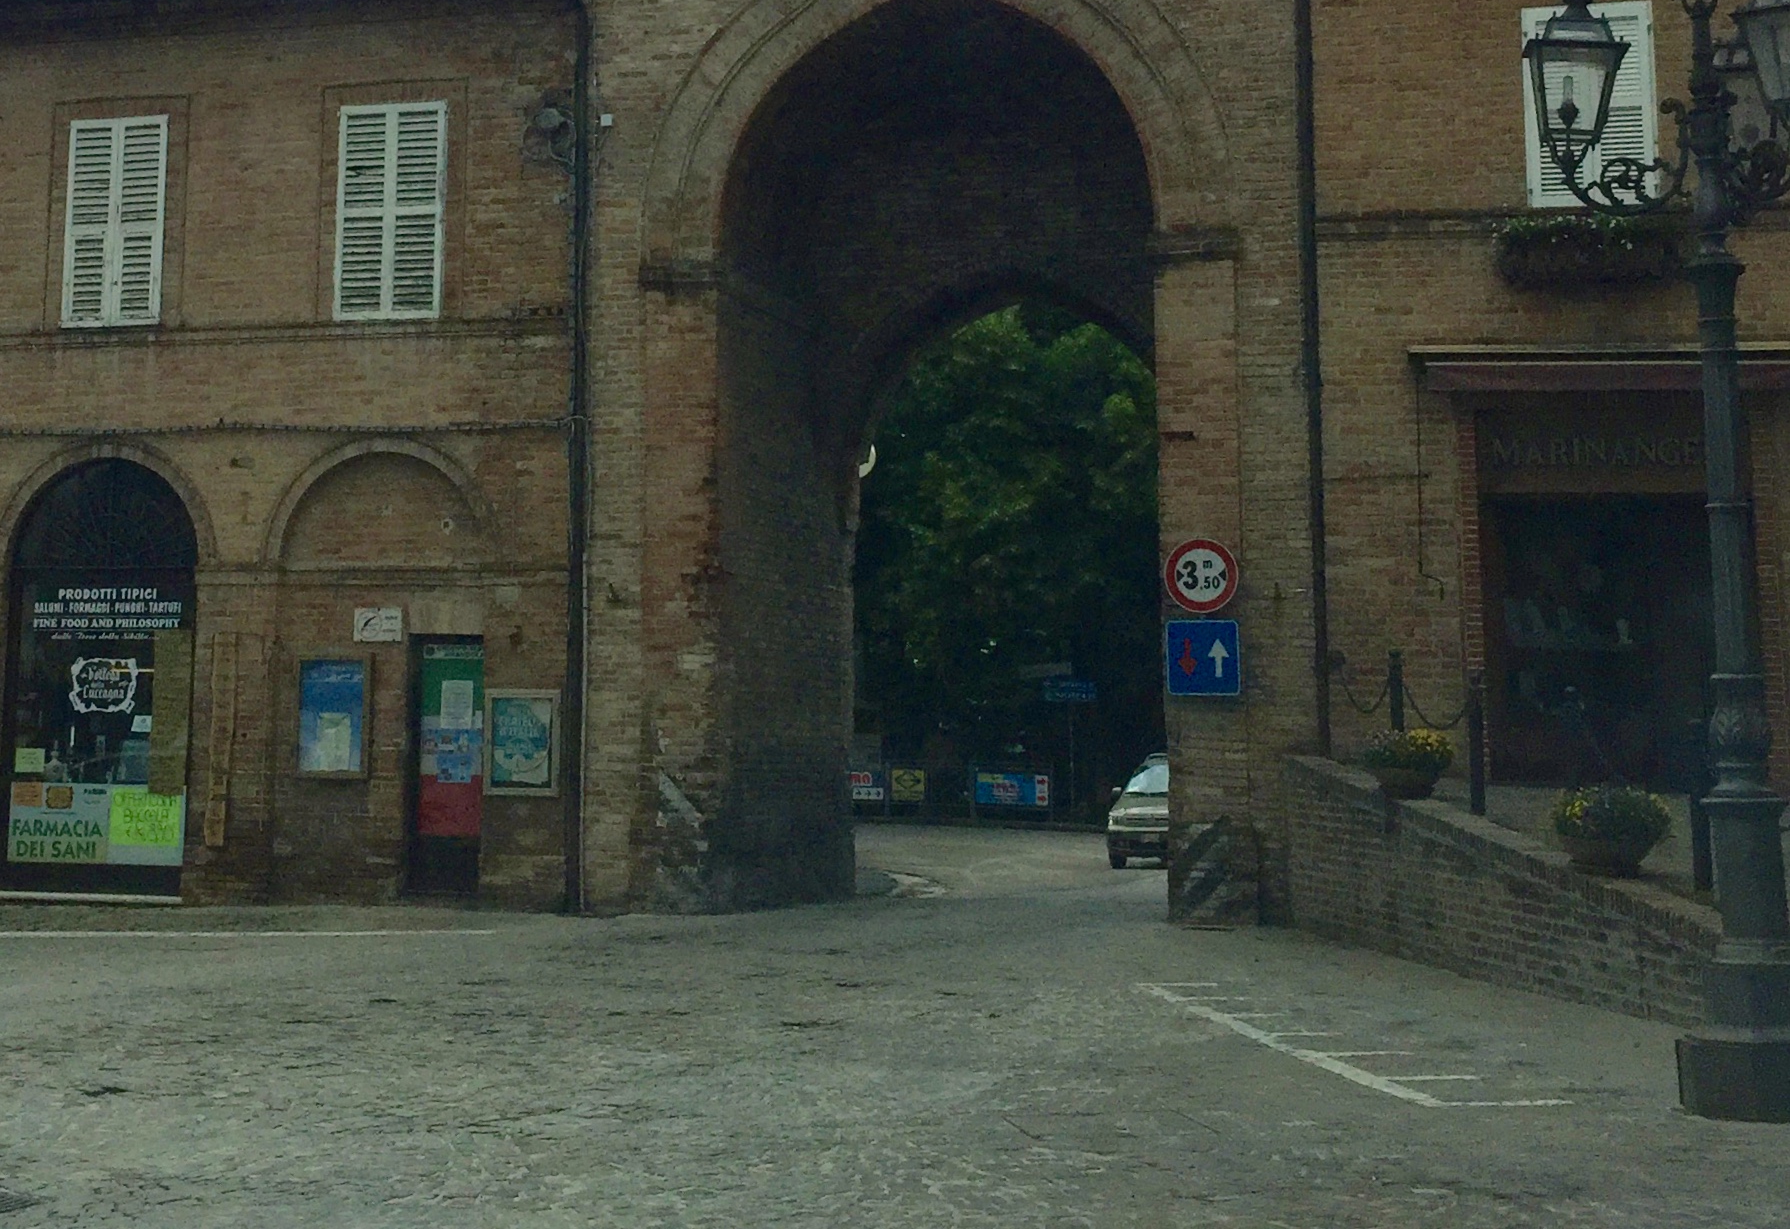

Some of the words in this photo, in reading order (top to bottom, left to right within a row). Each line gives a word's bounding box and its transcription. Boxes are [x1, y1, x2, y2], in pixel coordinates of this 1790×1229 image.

[1493, 437, 1703, 466] MARINANGE
[58, 588, 117, 600] PRODOTTI
[120, 587, 157, 600] TIPICI
[34, 602, 64, 613] SALUMI
[68, 602, 110, 613] FORMAGGI
[114, 602, 145, 613] FUNGHI
[149, 601, 182, 613] TARTUFI
[33, 618, 58, 628] FINE
[60, 618, 89, 628] FOOD
[90, 618, 114, 628] AND
[115, 618, 181, 628] PHILOSOPHY
[11, 818, 103, 838] FARMACIA
[16, 841, 45, 858] DEI
[51, 841, 96, 859] SANI
